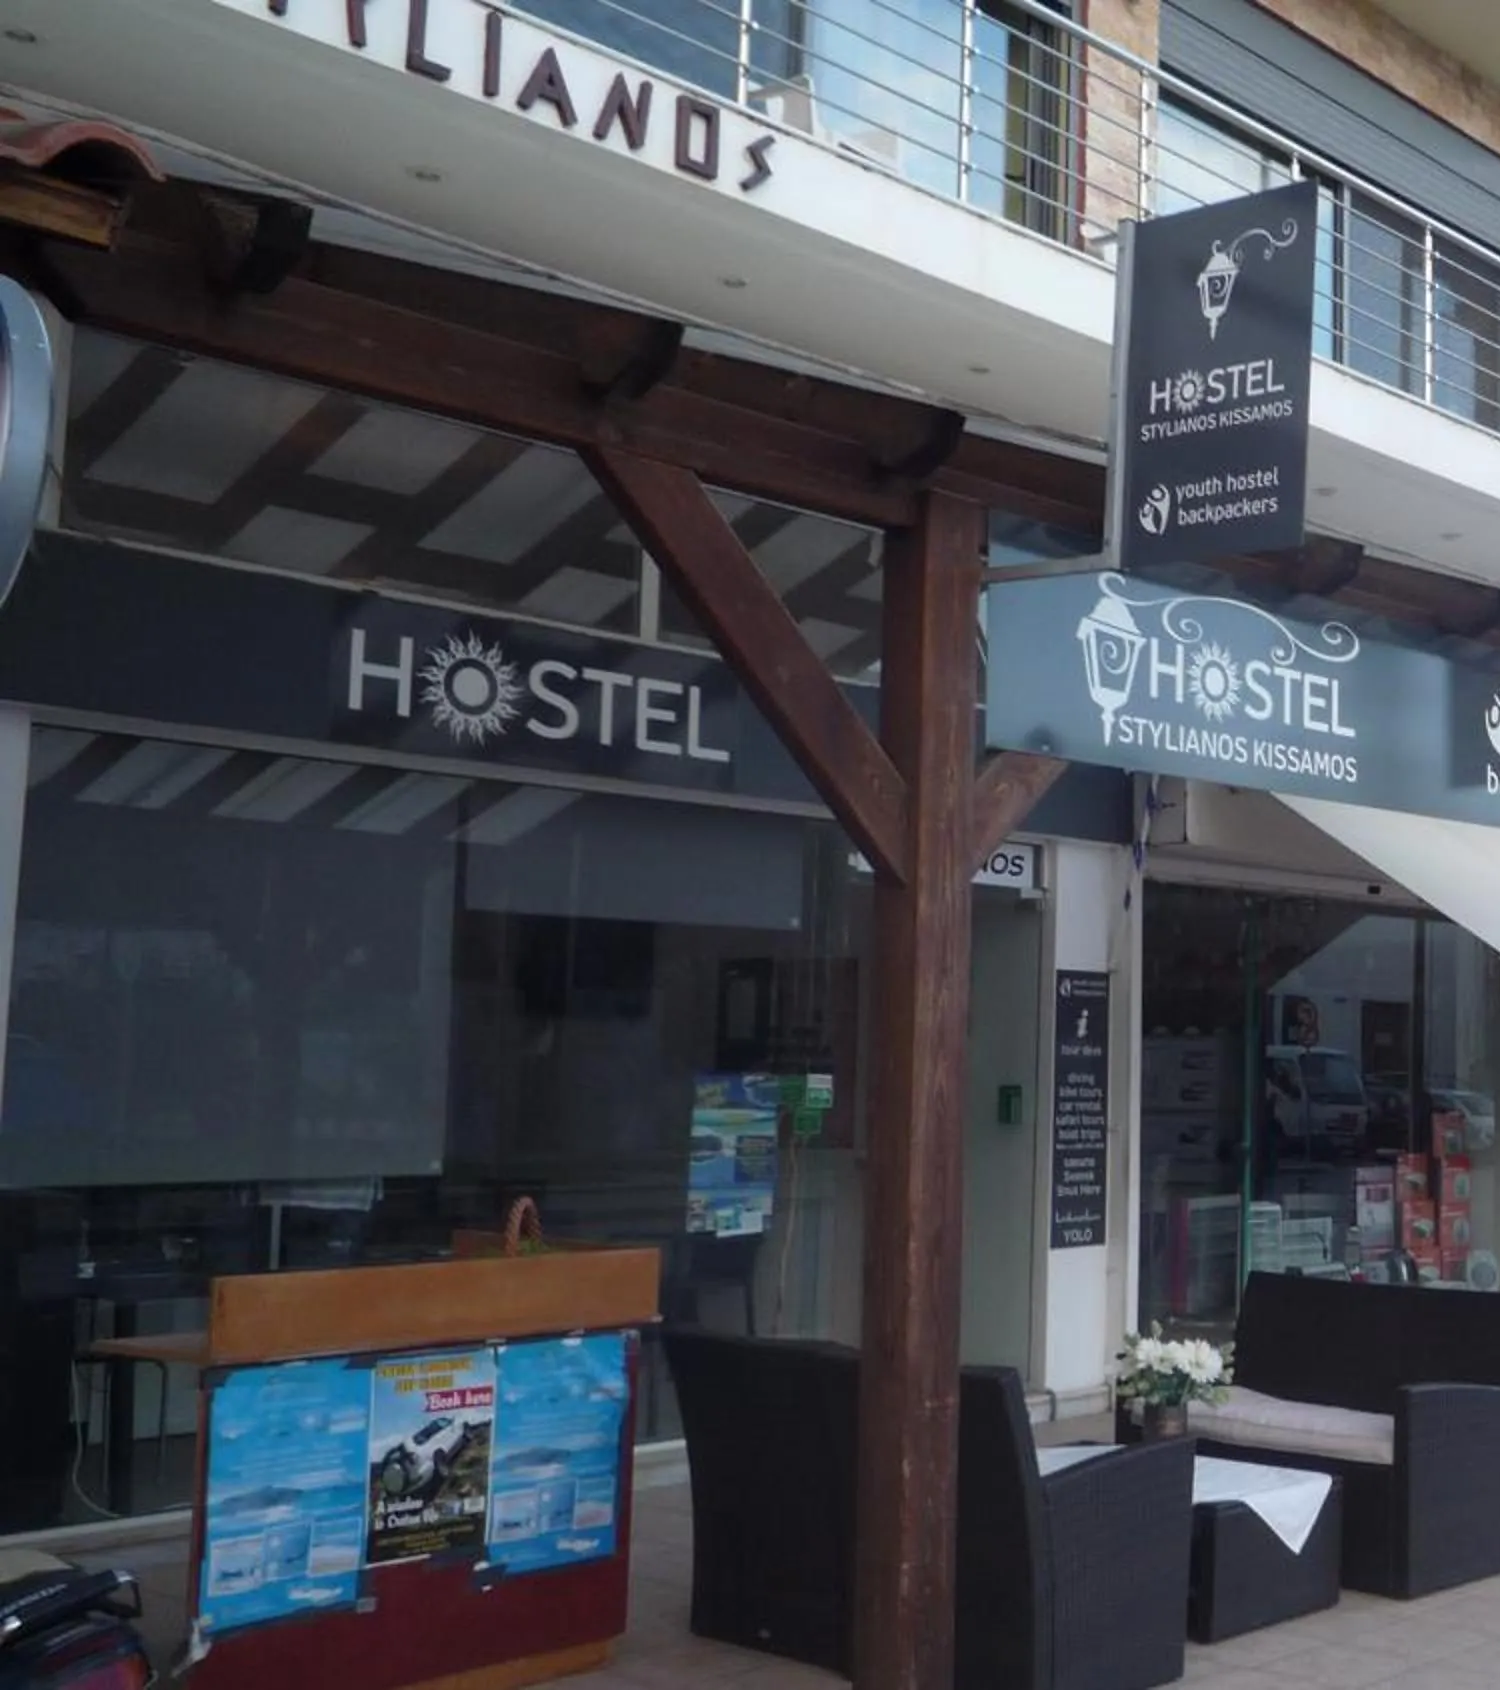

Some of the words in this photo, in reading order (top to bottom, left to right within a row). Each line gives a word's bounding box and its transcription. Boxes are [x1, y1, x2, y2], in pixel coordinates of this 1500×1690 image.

[266, 0, 776, 191] LIANOS
[1150, 358, 1285, 415] HOSTEL
[1141, 413, 1217, 442] STYLIANOS
[1219, 399, 1294, 428] KISSAMOS
[1175, 476, 1223, 505] youth
[1227, 466, 1280, 493] hostel
[1177, 496, 1279, 526] backpackers
[348, 628, 730, 762] HOSTEL
[1150, 636, 1356, 739] HOSTEL
[1118, 714, 1248, 764] STYLIANOS
[1253, 739, 1358, 783] KISSAMOS
[981, 852, 1026, 877] OS
[1062, 1228, 1094, 1244] YOLO
[429, 1391, 462, 1411] Book
